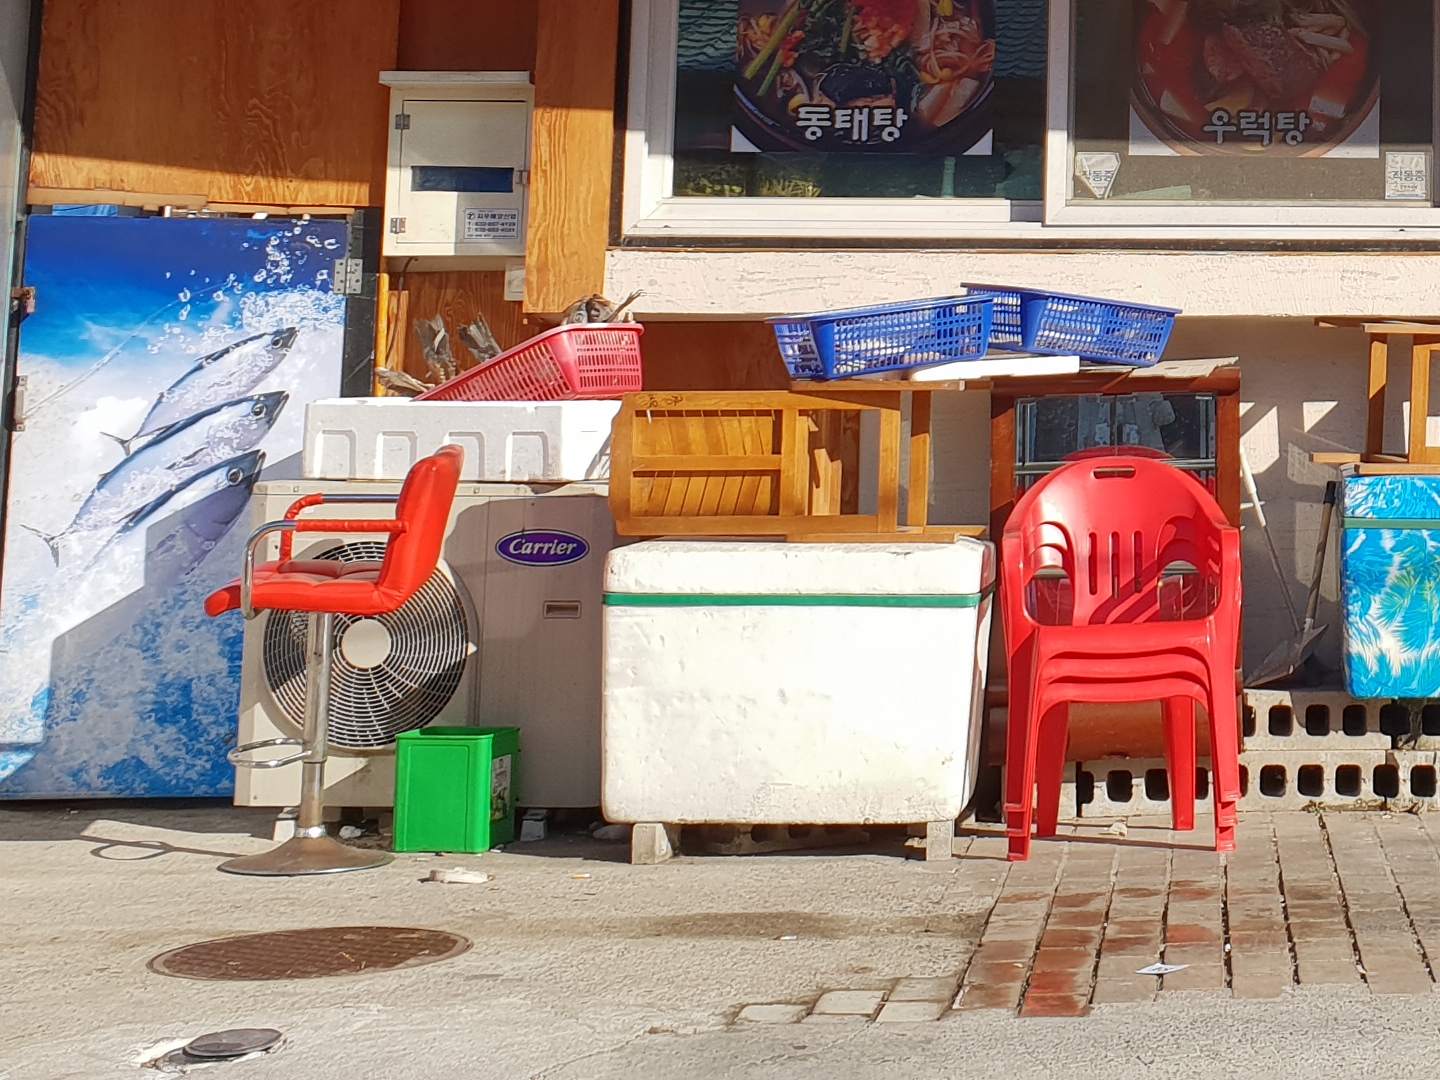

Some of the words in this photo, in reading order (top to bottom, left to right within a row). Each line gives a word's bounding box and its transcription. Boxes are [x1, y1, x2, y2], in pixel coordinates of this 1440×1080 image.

[796, 106, 908, 141] 동태탕
[1203, 110, 1310, 146] 우럭탕
[509, 538, 578, 555] Carrier
